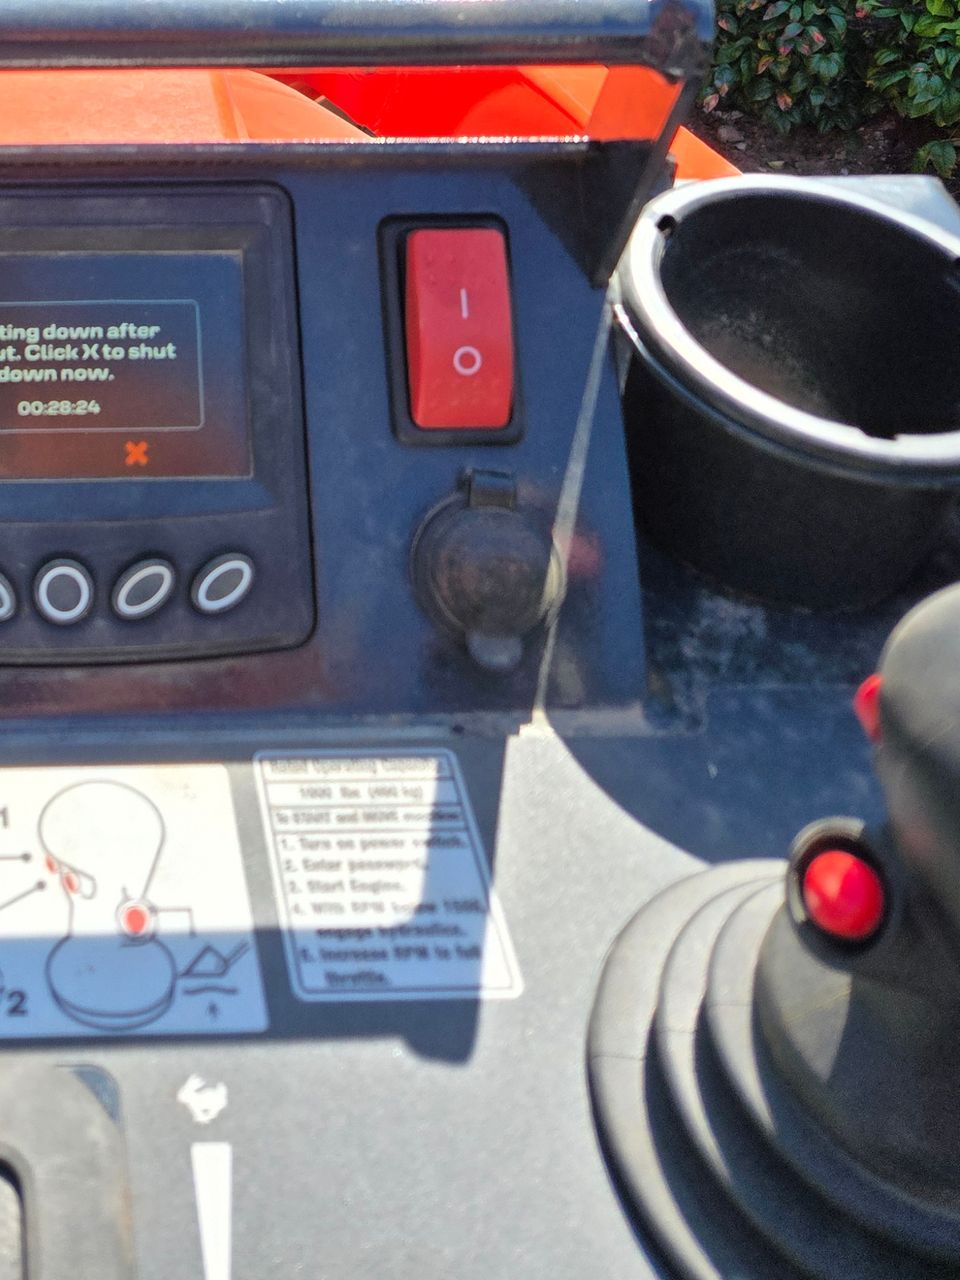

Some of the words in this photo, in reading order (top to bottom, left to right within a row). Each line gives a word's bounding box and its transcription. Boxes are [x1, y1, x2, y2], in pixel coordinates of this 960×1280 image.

[43, 324, 103, 340] down
[106, 323, 160, 340] after
[25, 344, 78, 361] Click
[81, 344, 100, 360] X
[103, 345, 125, 360] to
[128, 343, 176, 360] shut
[61, 368, 115, 382] now.
[18, 399, 100, 416] 00:28:24
[299, 837, 330, 850] Turn
[336, 839, 355, 850] on
[360, 839, 404, 852] power
[302, 858, 340, 871] Enter
[307, 880, 344, 893] Start
[7, 989, 29, 1017] 2
